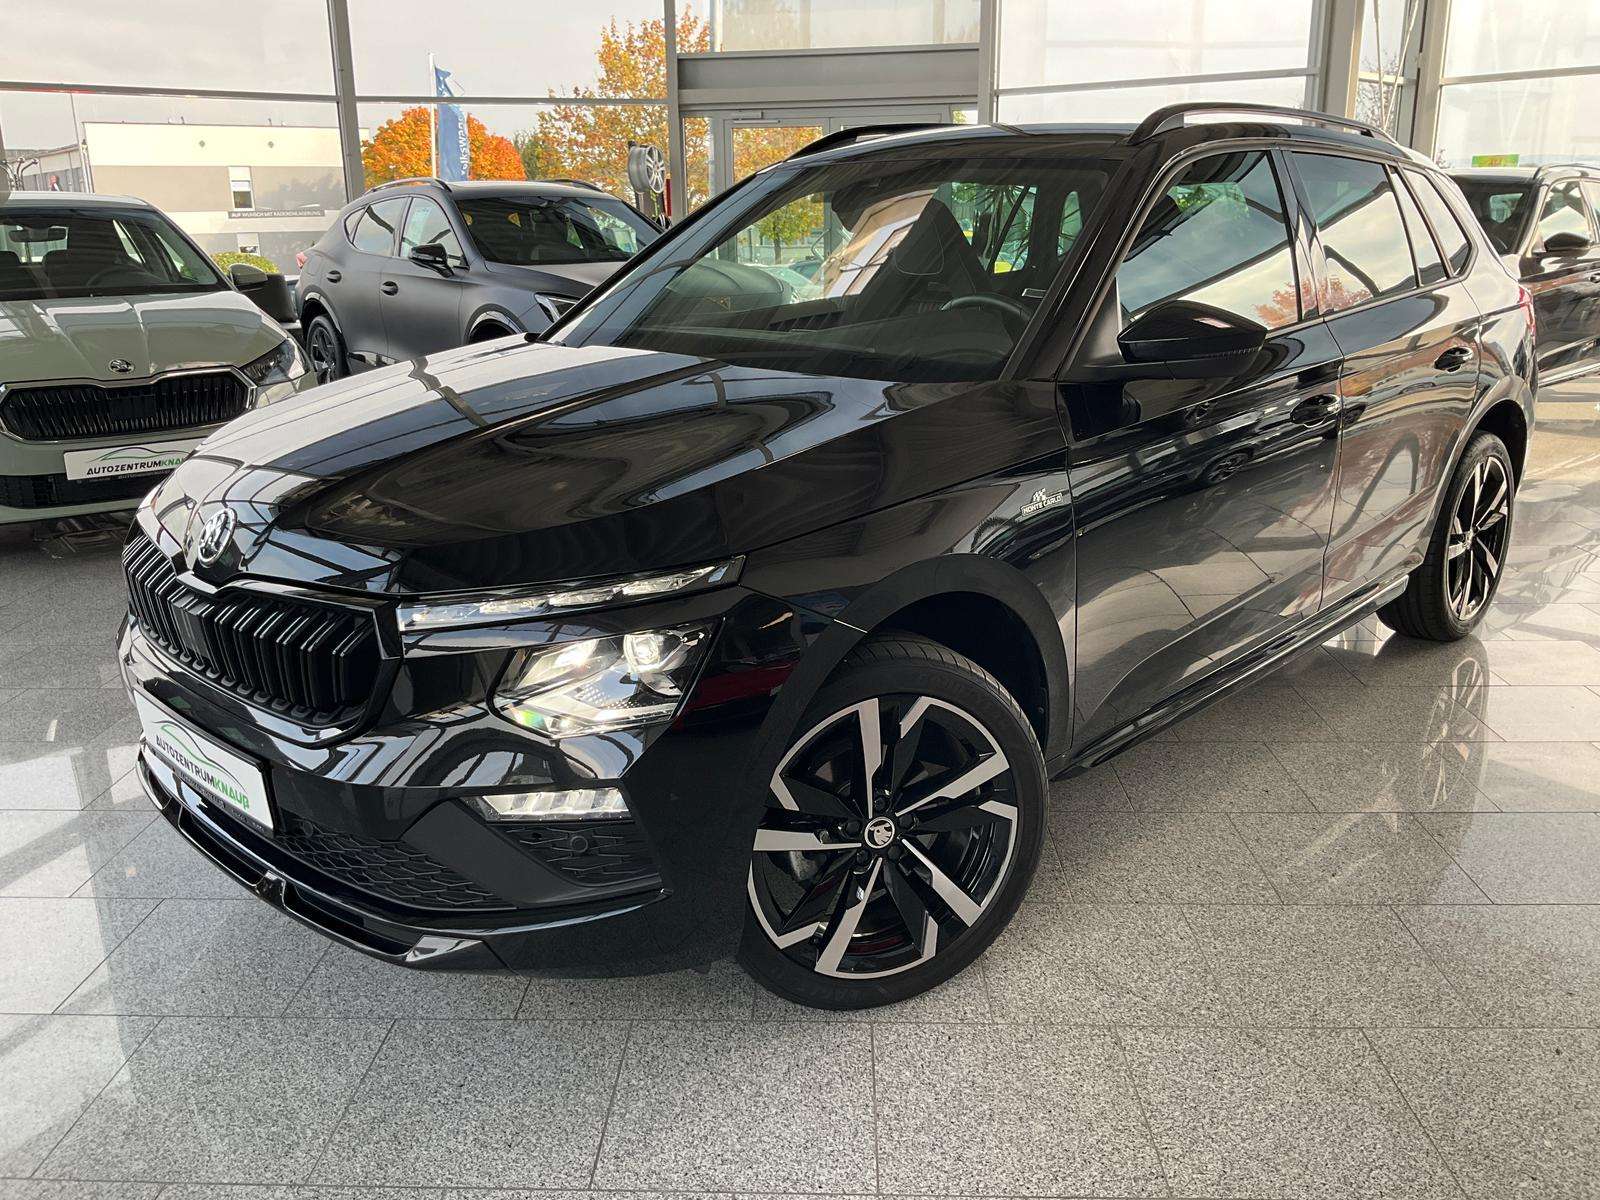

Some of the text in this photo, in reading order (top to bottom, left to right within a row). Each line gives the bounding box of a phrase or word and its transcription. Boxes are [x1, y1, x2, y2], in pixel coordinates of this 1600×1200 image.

[86, 457, 184, 476] AUTOZENTRUMKNA
[1023, 495, 1062, 514] MONTE CARLO
